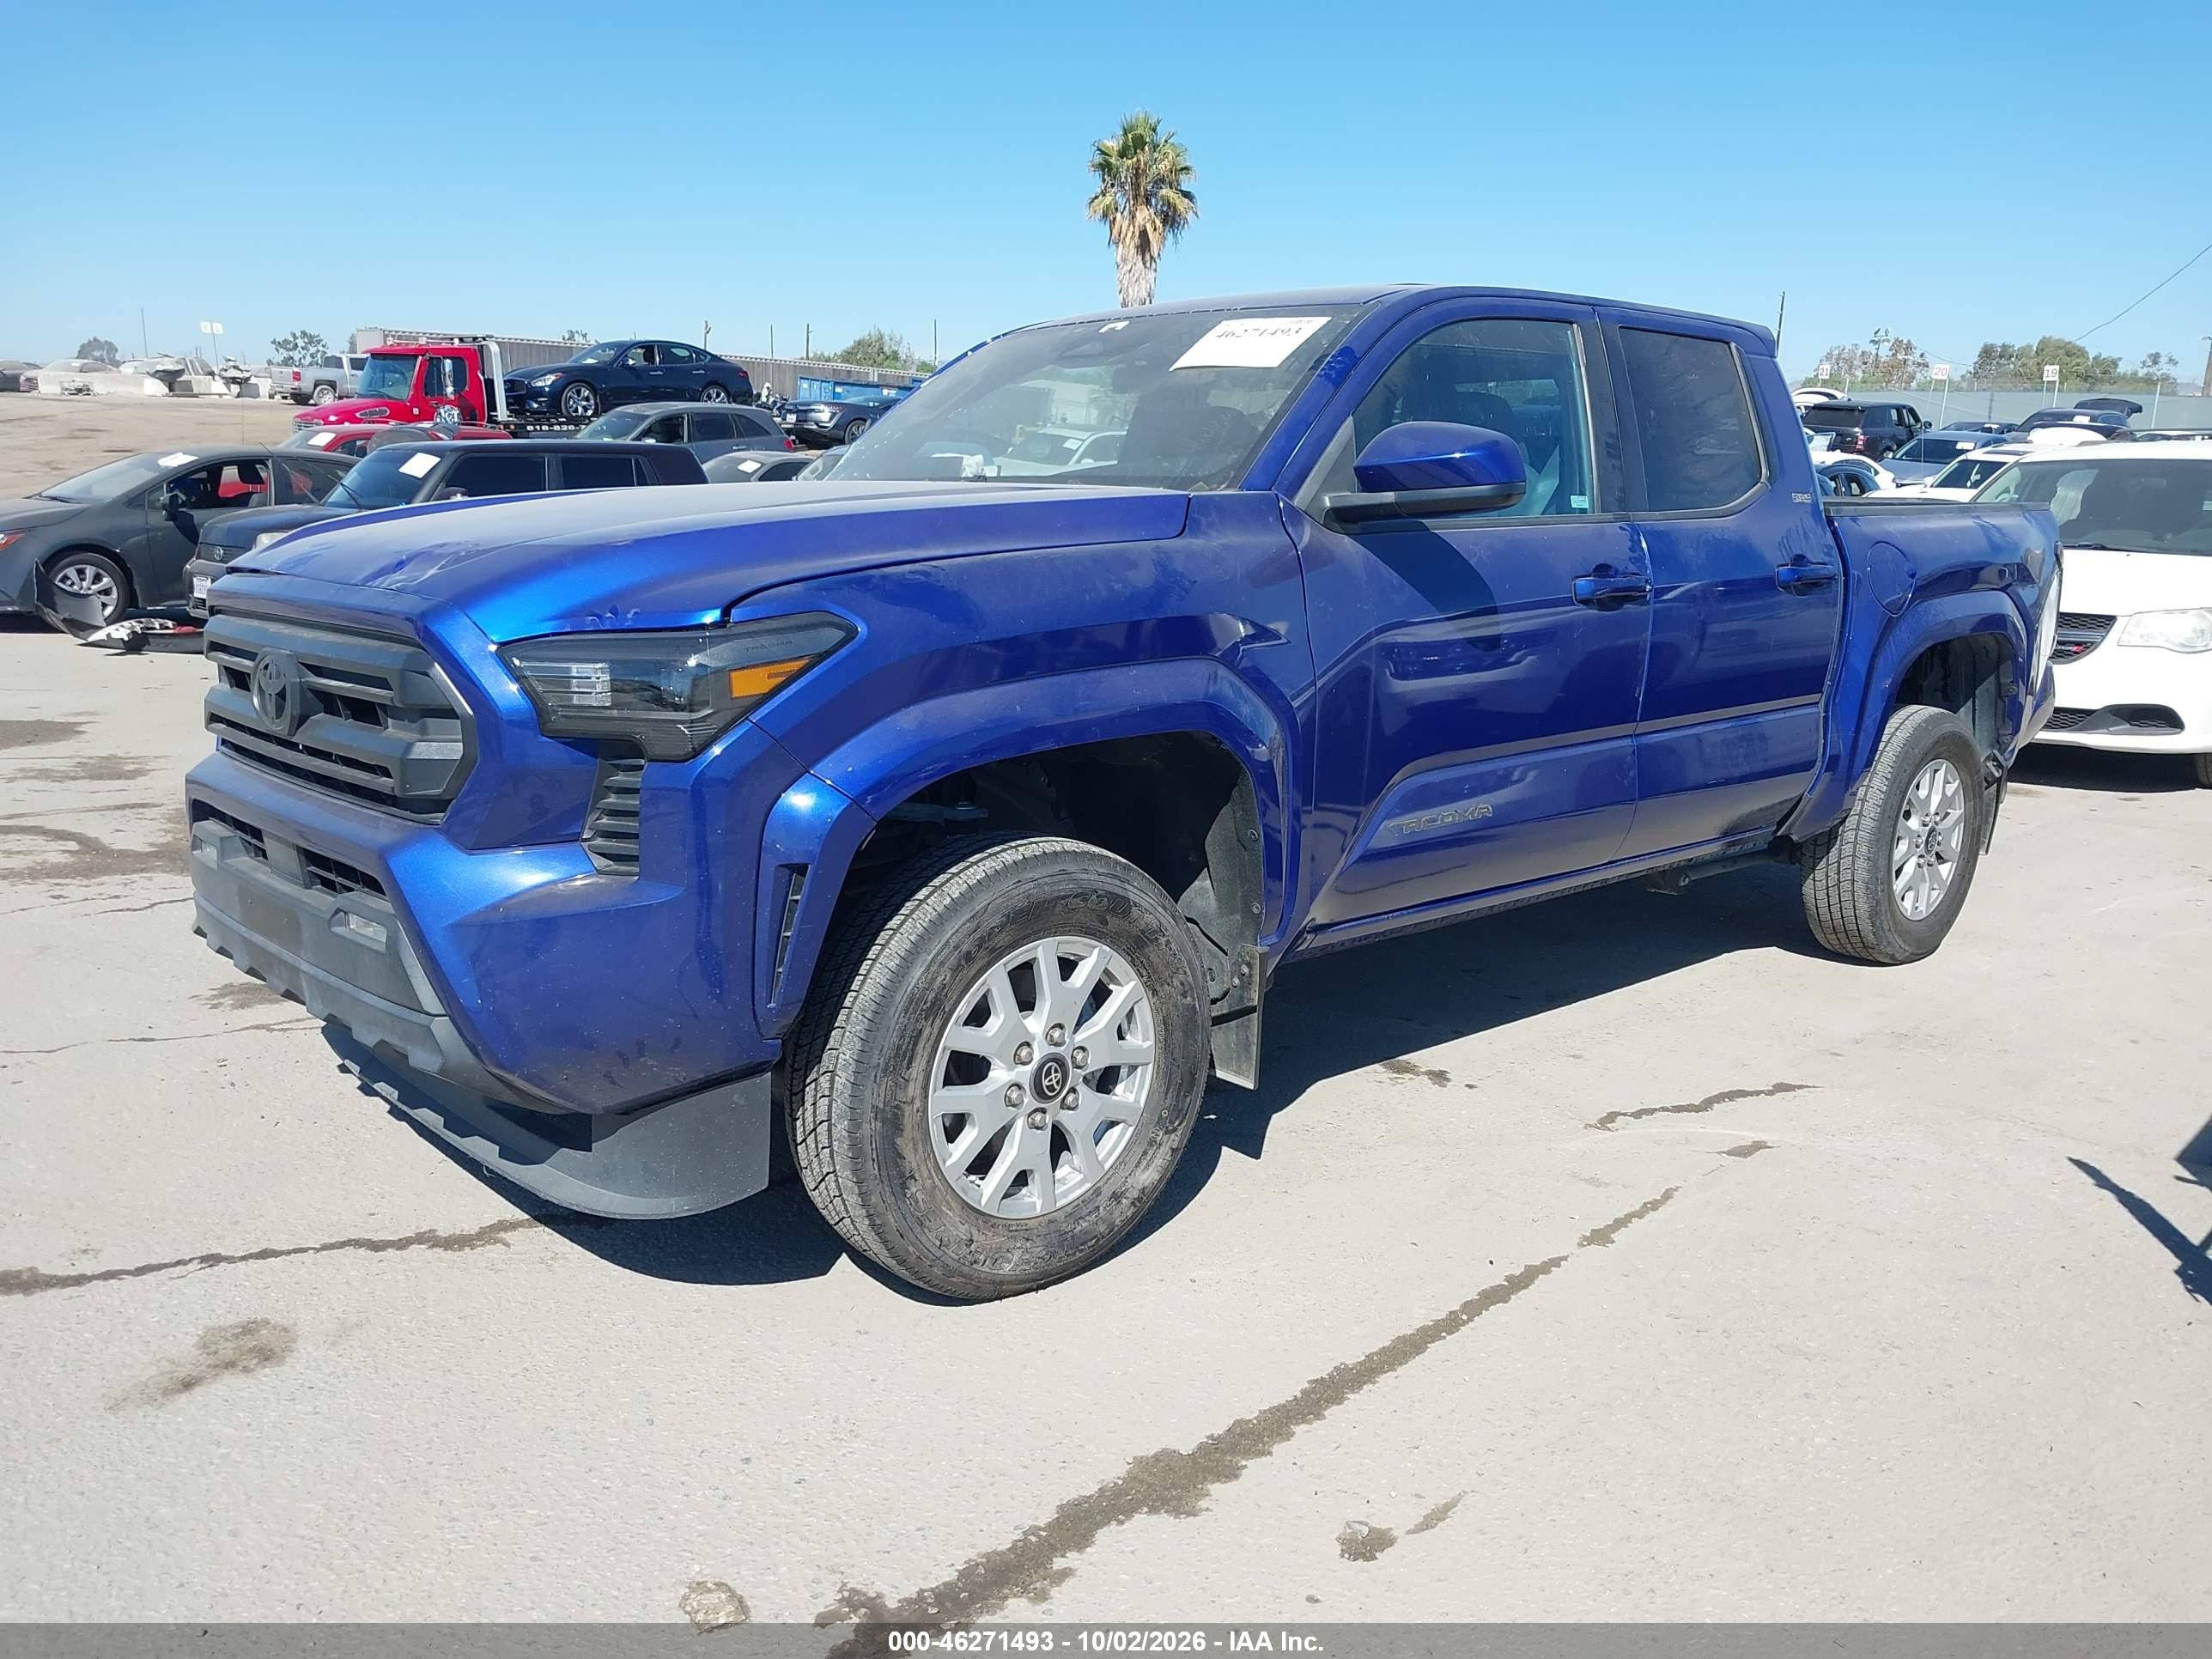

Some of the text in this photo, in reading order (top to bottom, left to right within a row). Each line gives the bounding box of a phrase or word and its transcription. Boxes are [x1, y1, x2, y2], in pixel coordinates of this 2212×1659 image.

[1820, 368, 1829, 376] 21
[1934, 367, 1948, 376] 20
[2045, 368, 2057, 378] 19
[1388, 804, 1492, 836] TACOMA
